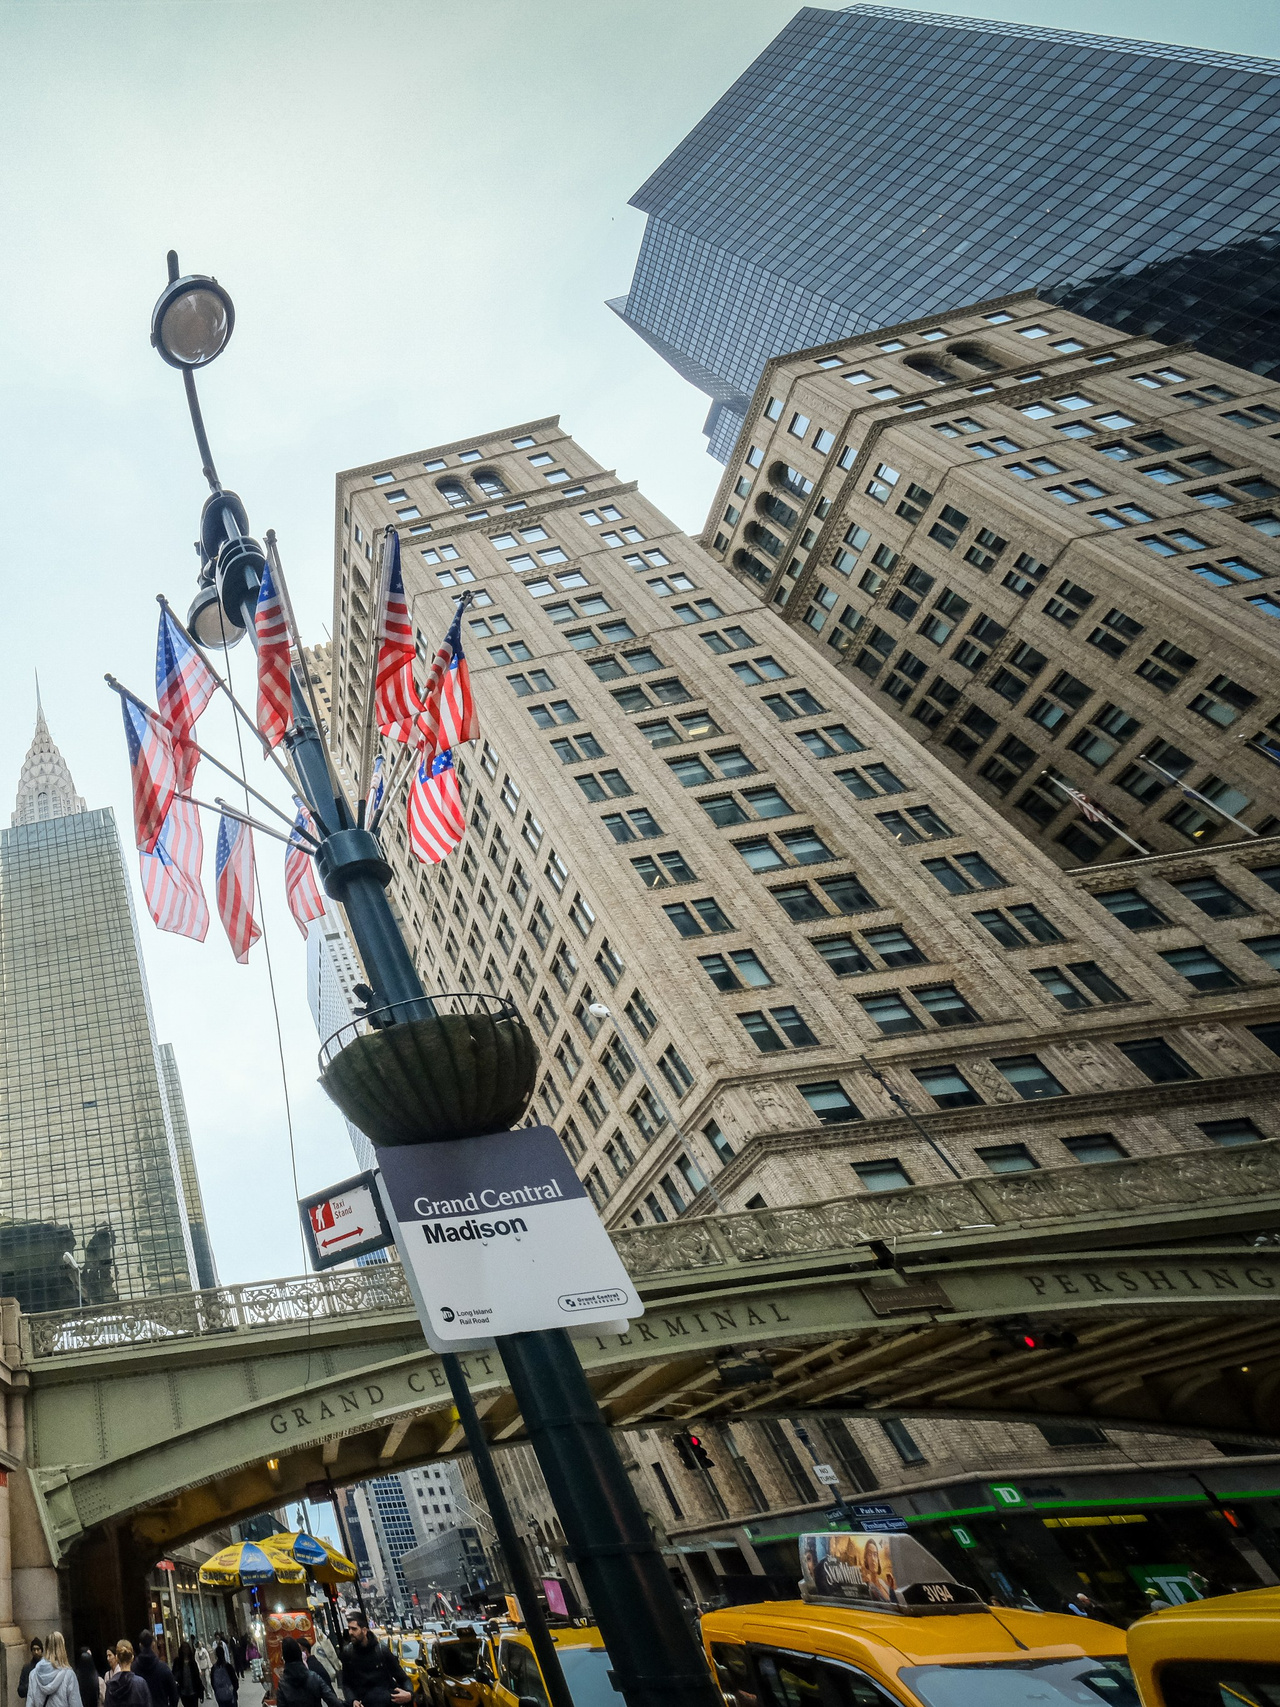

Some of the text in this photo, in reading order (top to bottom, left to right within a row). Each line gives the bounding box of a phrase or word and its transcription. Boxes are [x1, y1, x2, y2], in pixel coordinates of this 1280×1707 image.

[332, 1198, 345, 1210] Taxi
[413, 1178, 564, 1217] Grand Central
[334, 1205, 353, 1219] Stand
[422, 1217, 528, 1244] Madison
[1024, 1267, 1275, 1296] PERSHING
[577, 1292, 619, 1303] Grand Central
[456, 1308, 493, 1318] Long Island
[270, 1384, 385, 1435] GRAND
[407, 1354, 494, 1393] CENT
[994, 1487, 1020, 1503] TD
[859, 1507, 875, 1515] Park
[922, 1584, 955, 1602] 3V94
